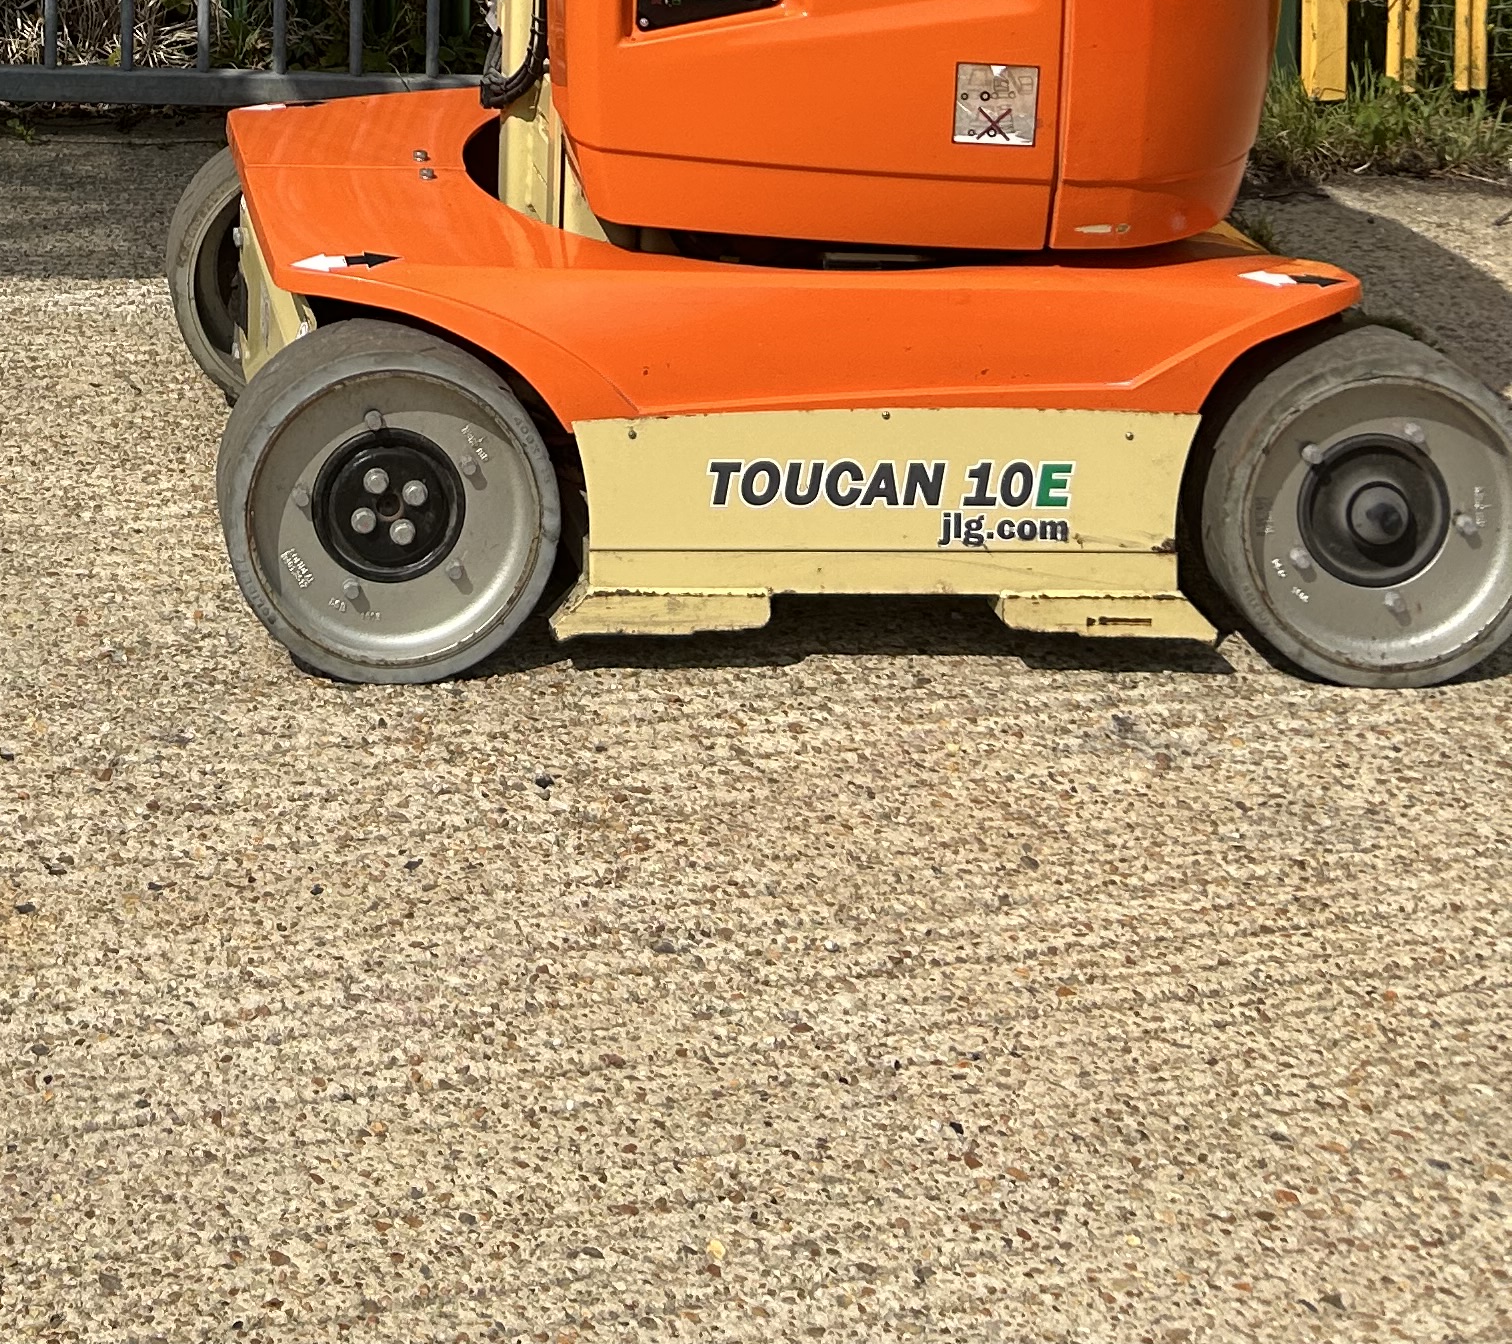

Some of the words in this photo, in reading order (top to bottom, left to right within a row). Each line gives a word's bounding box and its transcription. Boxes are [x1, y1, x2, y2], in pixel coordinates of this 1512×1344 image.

[707, 459, 947, 508] TOUCAN
[962, 460, 1074, 508] 10E
[938, 512, 1070, 546] jlg.com
